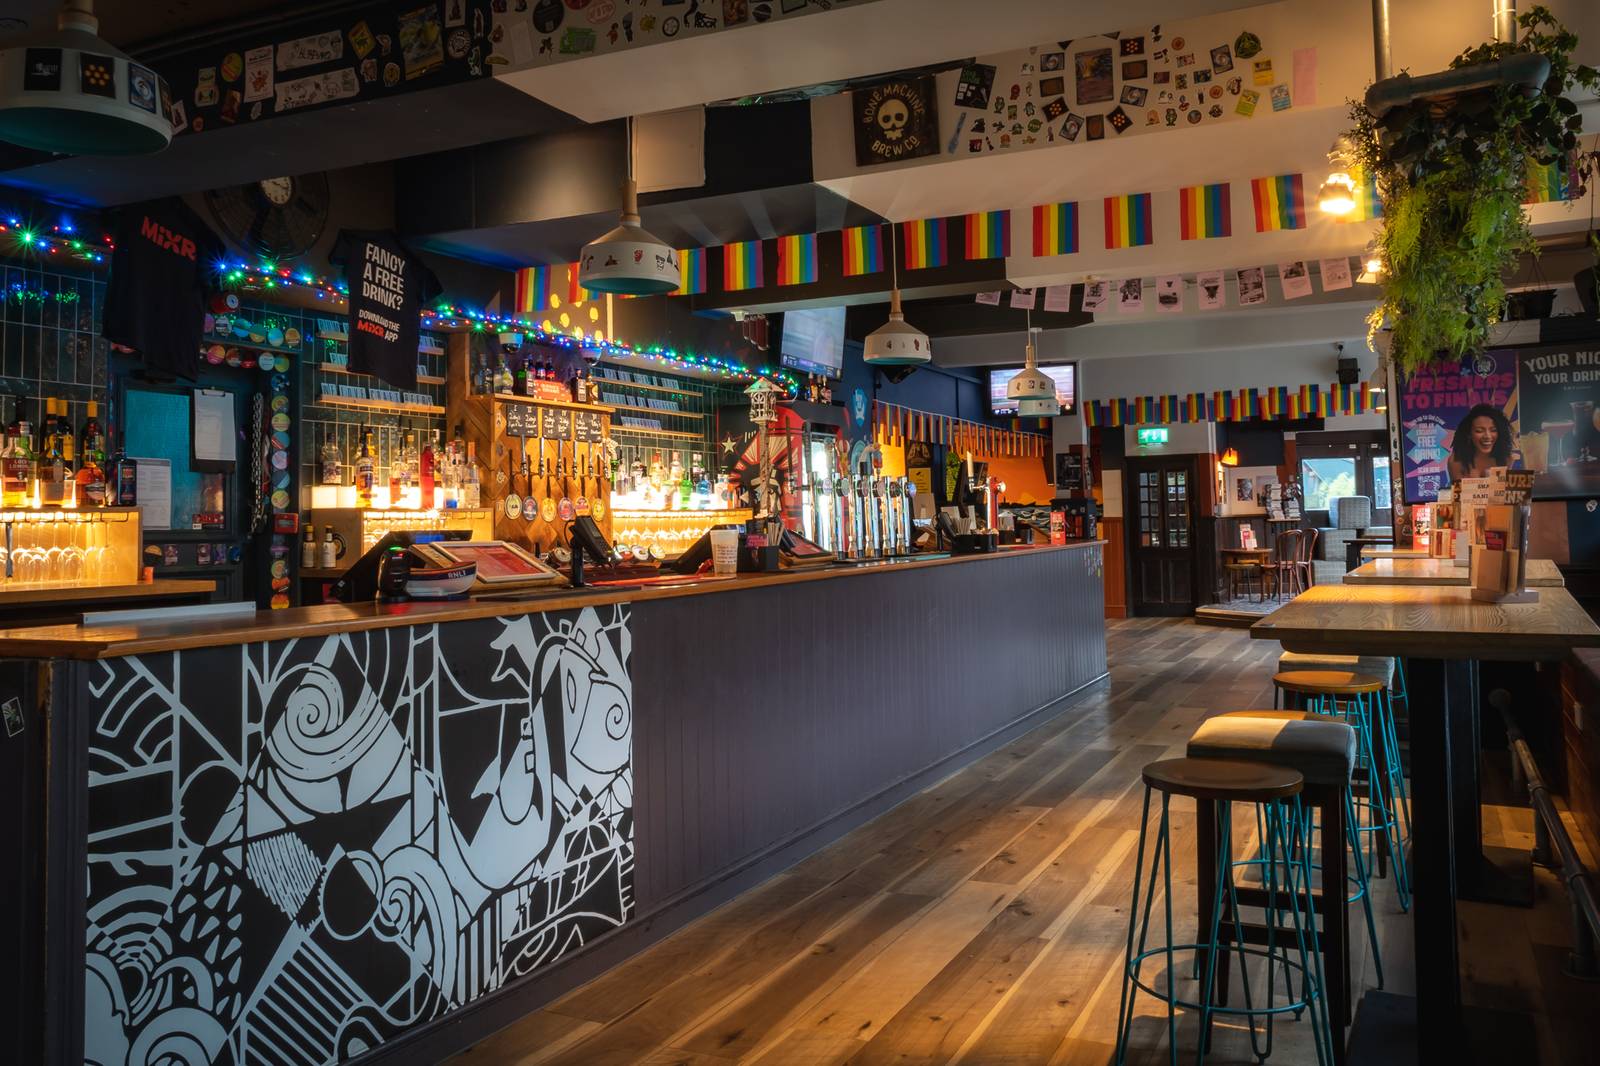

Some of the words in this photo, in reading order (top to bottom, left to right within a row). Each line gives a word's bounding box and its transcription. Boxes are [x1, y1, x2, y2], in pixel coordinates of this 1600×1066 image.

[863, 91, 882, 122] BONE
[884, 84, 925, 114] MACHINE
[871, 140, 903, 157] BREW
[365, 242, 405, 275] FANCY
[363, 262, 372, 281] A
[375, 266, 404, 295] FREE
[362, 281, 404, 311] DRINK?
[384, 330, 398, 343] APP
[388, 320, 401, 333] THE
[1524, 353, 1570, 373] YOUR
[1407, 371, 1515, 393] FRESHERS
[1535, 372, 1569, 385] YOUR
[1403, 393, 1430, 411] TO
[1434, 389, 1508, 408] FINALS
